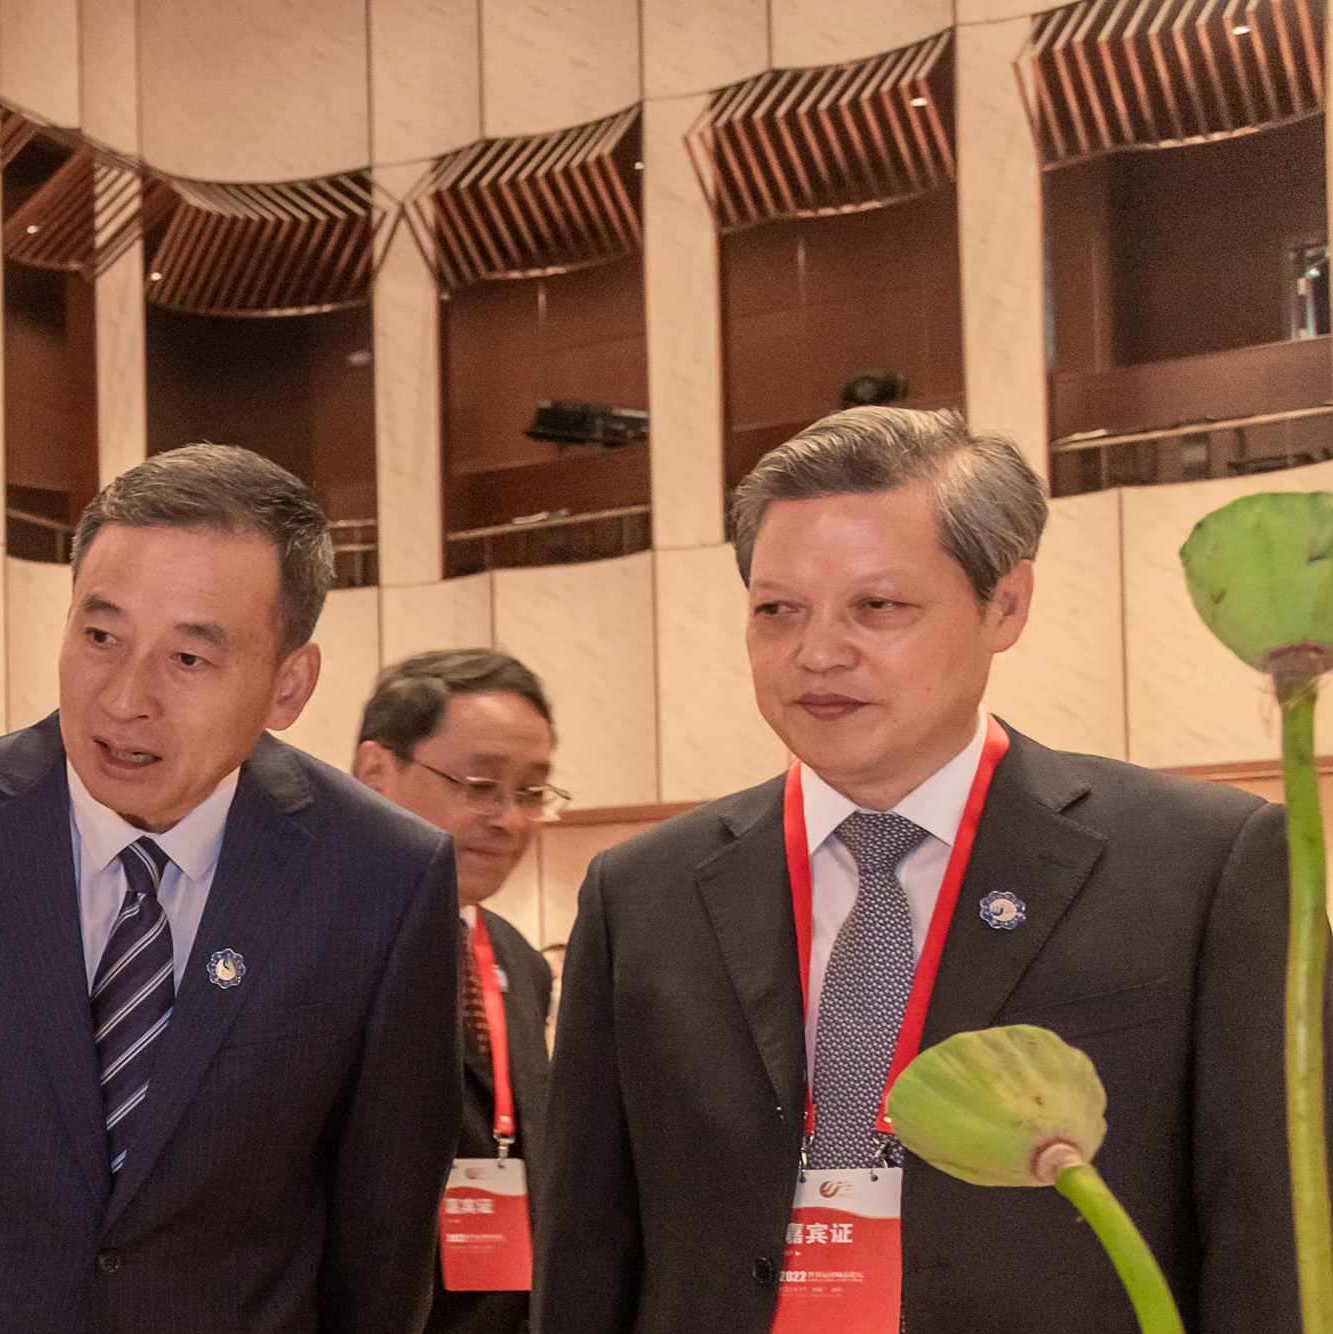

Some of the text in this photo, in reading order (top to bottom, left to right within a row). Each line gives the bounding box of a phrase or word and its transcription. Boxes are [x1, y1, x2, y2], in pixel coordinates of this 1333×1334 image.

[785, 1222, 853, 1245] 嘉宾证
[779, 1270, 807, 1283] 2022
